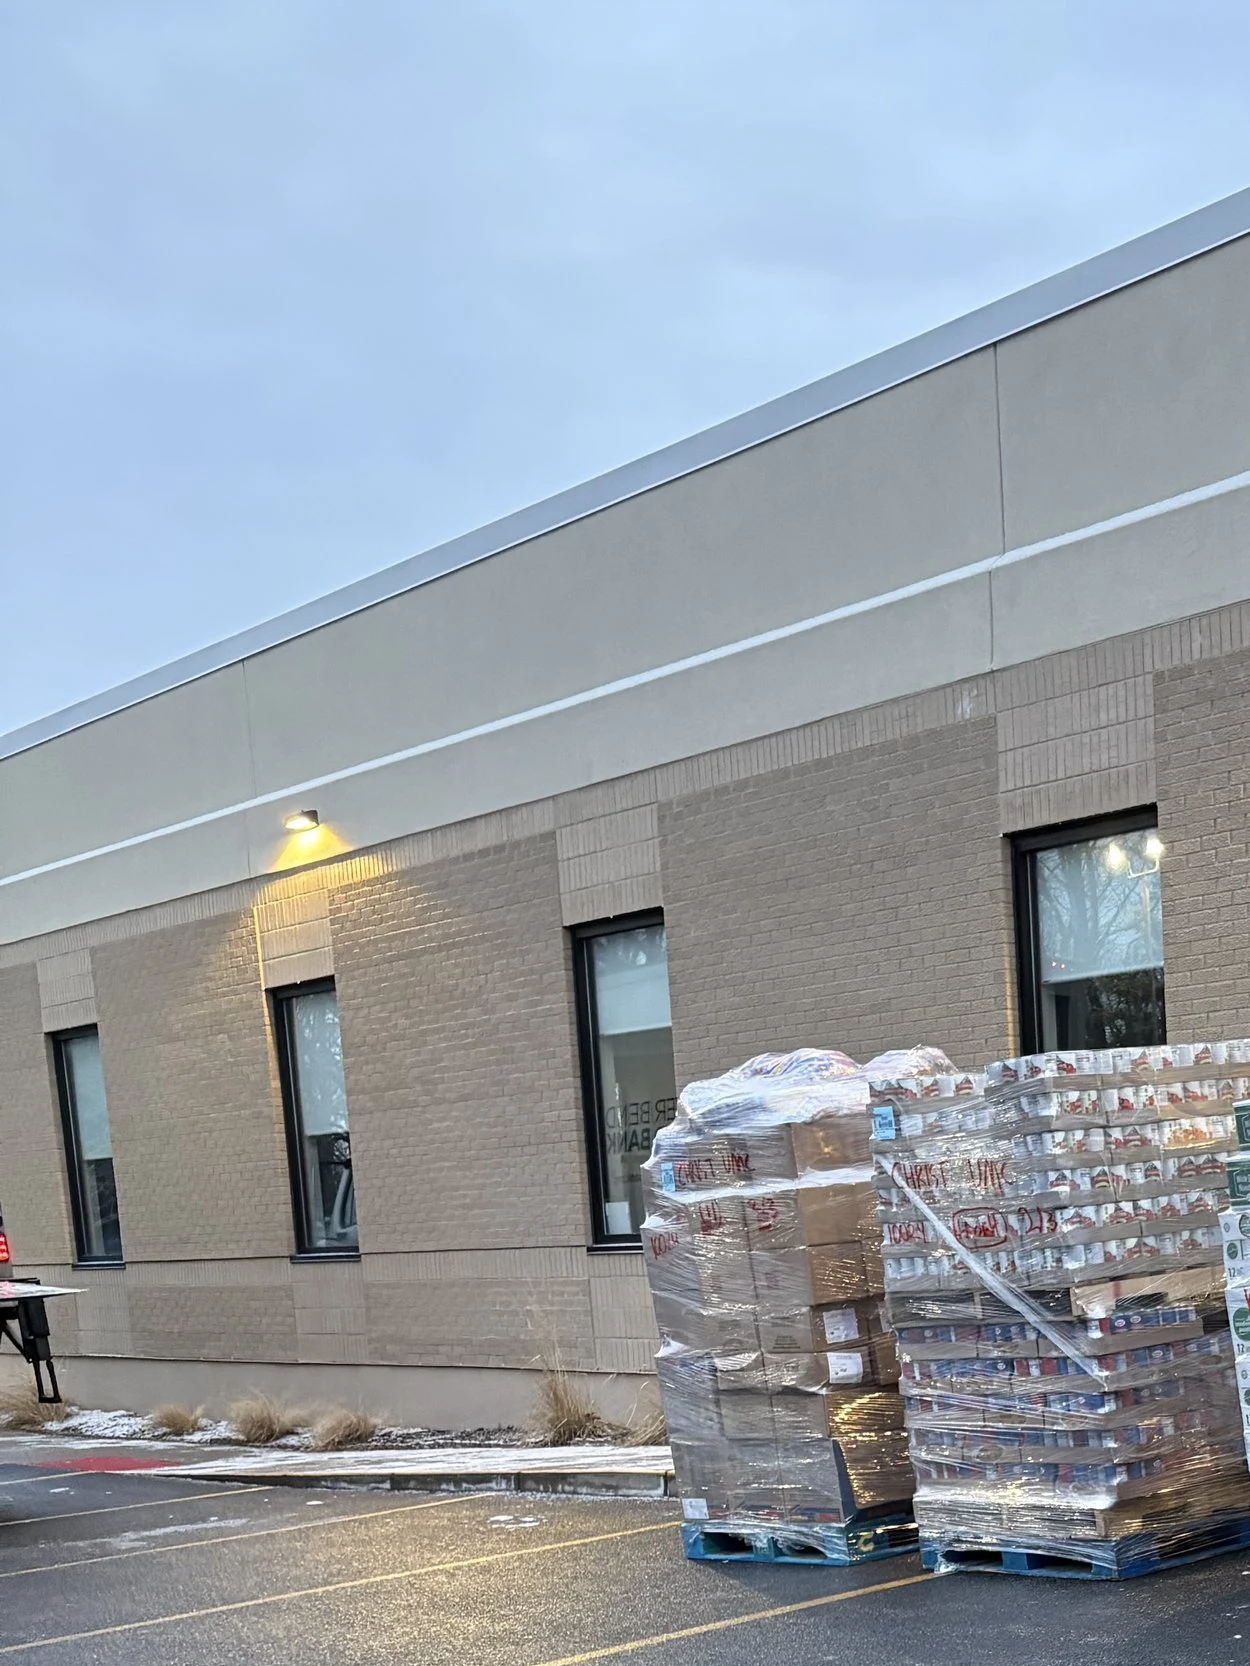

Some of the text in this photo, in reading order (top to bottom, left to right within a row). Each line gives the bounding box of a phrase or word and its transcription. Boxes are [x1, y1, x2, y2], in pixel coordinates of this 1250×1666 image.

[892, 1158, 1016, 1197] CHRIST UMC
[1236, 1343, 1245, 1353] 12
